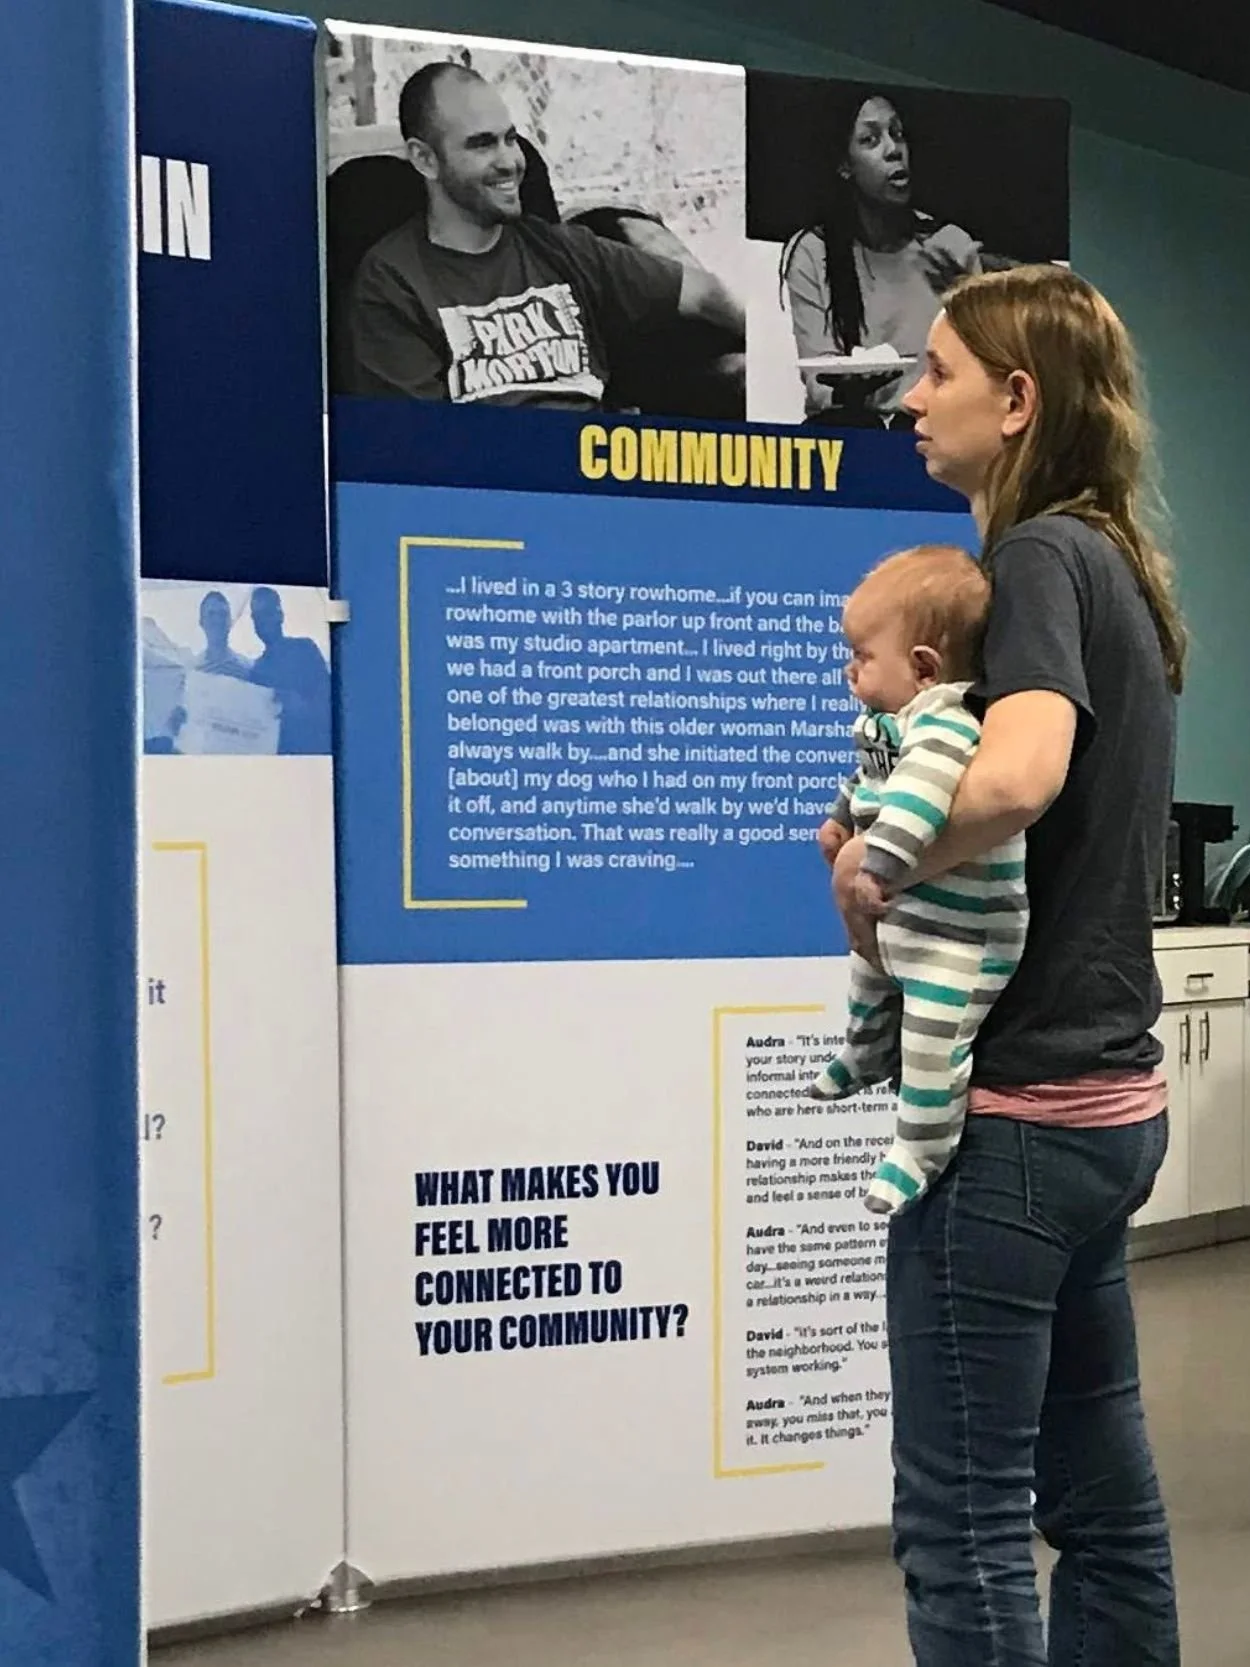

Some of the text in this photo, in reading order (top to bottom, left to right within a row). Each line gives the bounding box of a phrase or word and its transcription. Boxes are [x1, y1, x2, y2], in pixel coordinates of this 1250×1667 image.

[141, 154, 211, 261] IN
[462, 339, 581, 393] MORTON
[579, 424, 845, 491] COMMUNITY
[445, 604, 537, 623] rowhome
[541, 607, 582, 624] with
[586, 608, 617, 626] the
[622, 610, 678, 630] parlor
[681, 616, 706, 632] up
[709, 612, 753, 630] front
[757, 615, 790, 632] and
[795, 615, 824, 632] the
[446, 658, 842, 685] we had a front porch and I was out there all
[446, 689, 483, 703] one
[487, 686, 507, 704] of
[511, 687, 543, 705] the
[546, 691, 625, 709] greatest
[629, 691, 747, 712] relationships
[751, 693, 806, 710] where
[811, 695, 816, 711] I
[447, 713, 537, 736] belonged
[542, 720, 581, 733] was
[585, 716, 625, 733] with
[630, 717, 664, 734] this
[668, 717, 715, 735] older
[719, 723, 785, 736] woman
[448, 767, 518, 790] [about]
[523, 773, 552, 790] my
[556, 769, 593, 791] dog
[598, 770, 638, 787] who
[642, 770, 648, 787] I
[652, 770, 687, 788] had
[692, 774, 715, 788] on
[719, 775, 747, 792] my
[751, 771, 793, 788] front
[148, 977, 166, 1005] it
[746, 1100, 888, 1116] who are here short-term
[746, 1152, 877, 1170] having a more friendly
[415, 1161, 660, 1206] WHAT MAKES YOU
[415, 1214, 568, 1256] FEEL MORE
[415, 1260, 622, 1306] CONNECTED TO
[416, 1304, 689, 1356] YOUR COMMUNITY?
